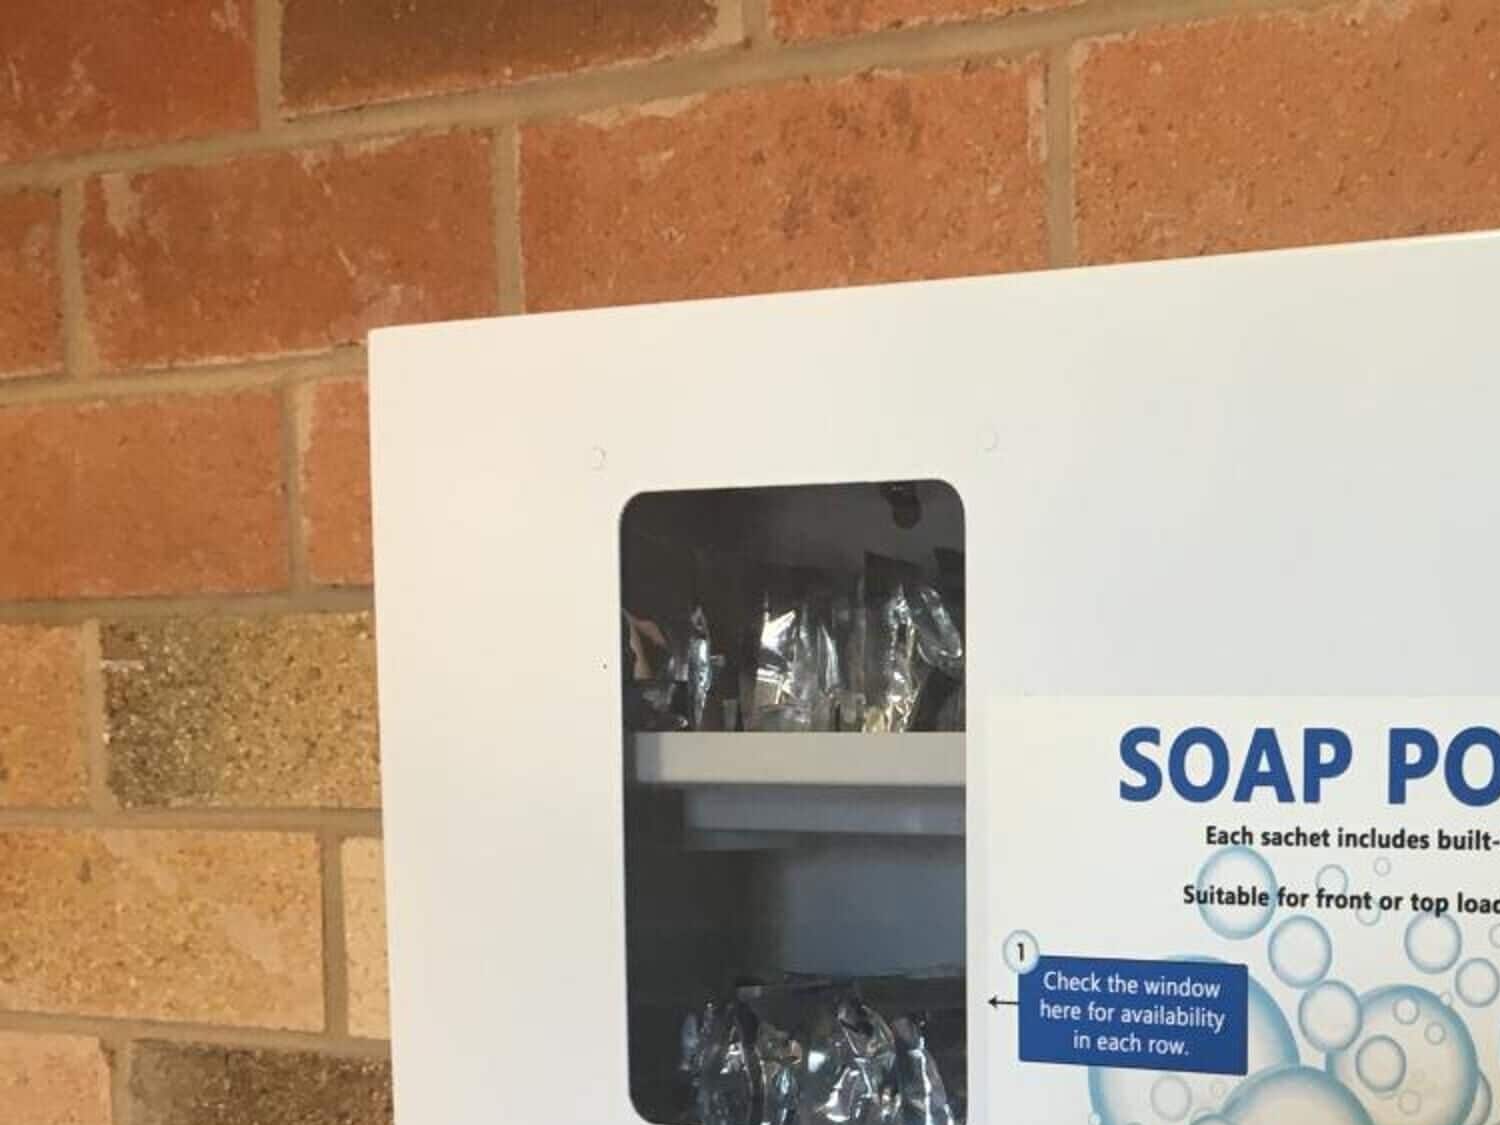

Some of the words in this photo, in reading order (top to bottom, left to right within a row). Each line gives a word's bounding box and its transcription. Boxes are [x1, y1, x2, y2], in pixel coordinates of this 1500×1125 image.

[1118, 725, 1353, 804] SOAP
[1206, 825, 1254, 846] Each
[1261, 826, 1330, 847] sachet
[1337, 828, 1430, 849] includes
[1183, 885, 1270, 907] Suitable
[1277, 886, 1310, 907] for
[1316, 889, 1373, 910] front
[1379, 896, 1403, 911] or
[1411, 893, 1449, 918] top
[1017, 942, 1024, 962] 1
[1043, 971, 1101, 993] Check
[1107, 974, 1138, 995] the
[1144, 976, 1221, 998] window
[1040, 1000, 1081, 1020] here
[1087, 1001, 1115, 1021] for
[1121, 1006, 1225, 1034] availability
[1073, 1030, 1090, 1049] in
[1097, 1032, 1141, 1053] each
[1149, 1039, 1189, 1056] row.
